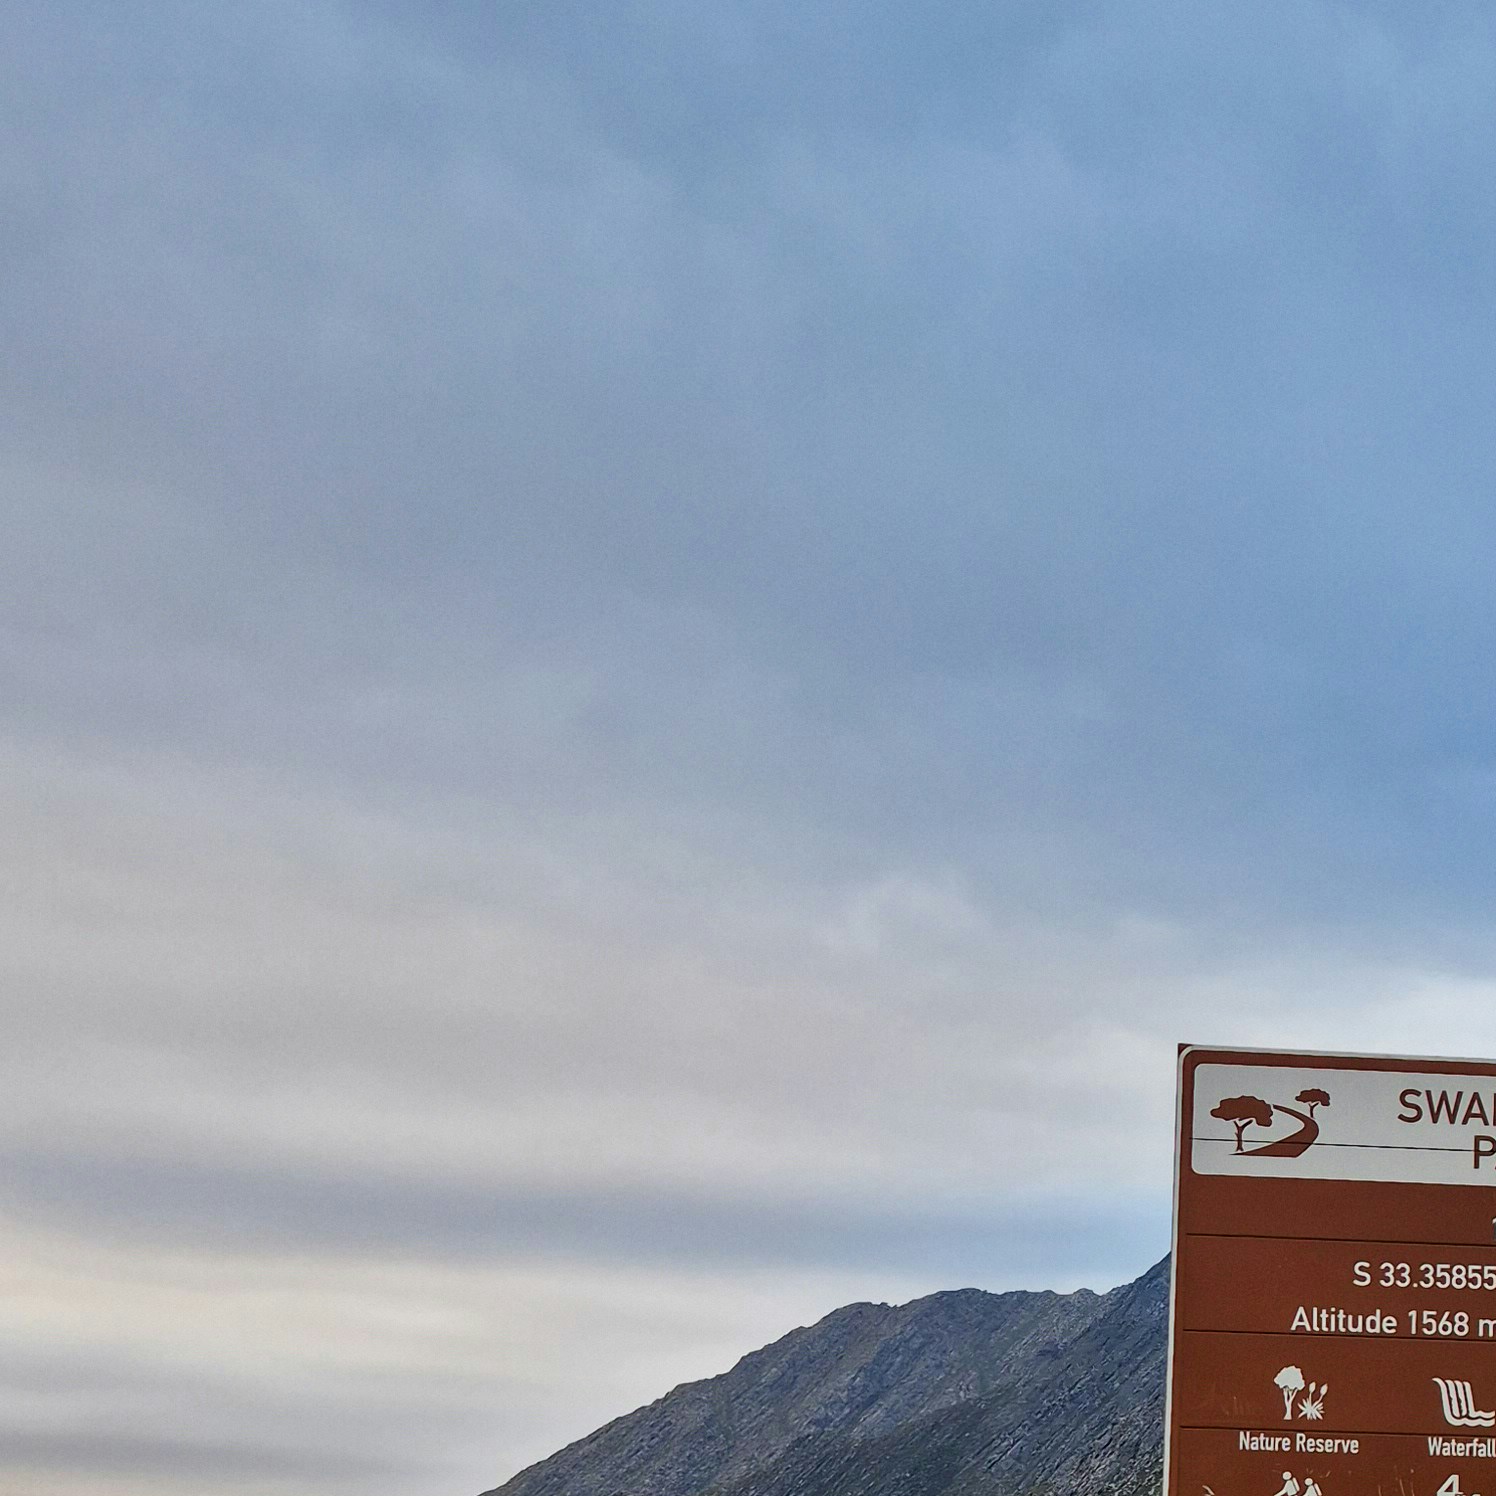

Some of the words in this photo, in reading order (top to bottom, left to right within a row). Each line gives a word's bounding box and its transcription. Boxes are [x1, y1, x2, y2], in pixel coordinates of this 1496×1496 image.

[1353, 1261, 1371, 1287] S
[1290, 1306, 1398, 1334] Altitude
[1408, 1310, 1469, 1337] 1568
[1239, 1431, 1291, 1452] Nature
[1296, 1433, 1359, 1454] Reserve
[1427, 1436, 1496, 1458] Waterfall
